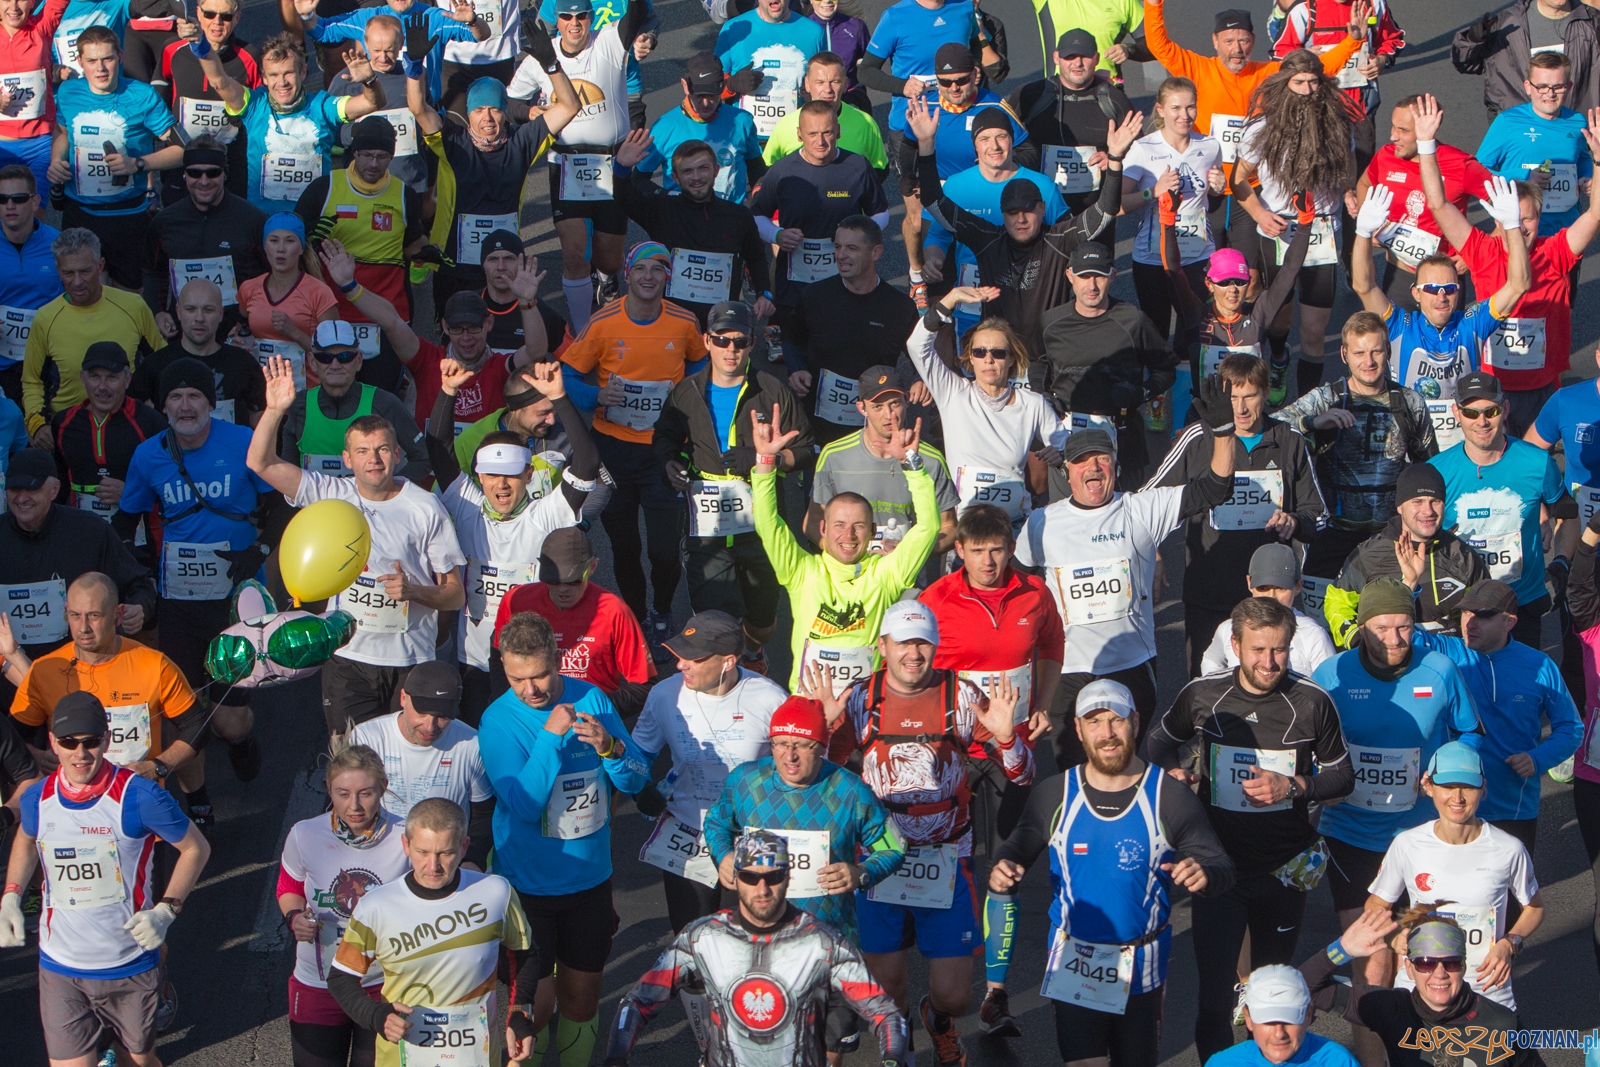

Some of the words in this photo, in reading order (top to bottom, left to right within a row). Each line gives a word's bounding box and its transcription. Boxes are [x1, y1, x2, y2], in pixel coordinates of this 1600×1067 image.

[753, 105, 785, 117] 1506
[273, 170, 313, 183] 3589
[576, 169, 602, 181] 452
[1054, 162, 1088, 174] 1595
[1383, 237, 1426, 260] 4948
[681, 266, 723, 283] 4365
[1495, 334, 1536, 350] 7047
[162, 473, 230, 505] Airpol
[974, 486, 1011, 502] 1373
[700, 498, 744, 513] 5963
[178, 561, 217, 577] 3515
[1070, 578, 1122, 600] 6940
[348, 588, 398, 610] 3434
[11, 602, 51, 619] 494
[1354, 769, 1407, 786] 4985
[566, 790, 600, 813] 224
[80, 826, 113, 835] TIMEX
[54, 861, 104, 883] 7081
[69, 885, 93, 893] Tomasz
[997, 902, 1018, 960] Kalenji
[1064, 957, 1119, 985] 4049
[418, 1028, 477, 1048] 2305
[440, 1052, 456, 1060] Piotr
